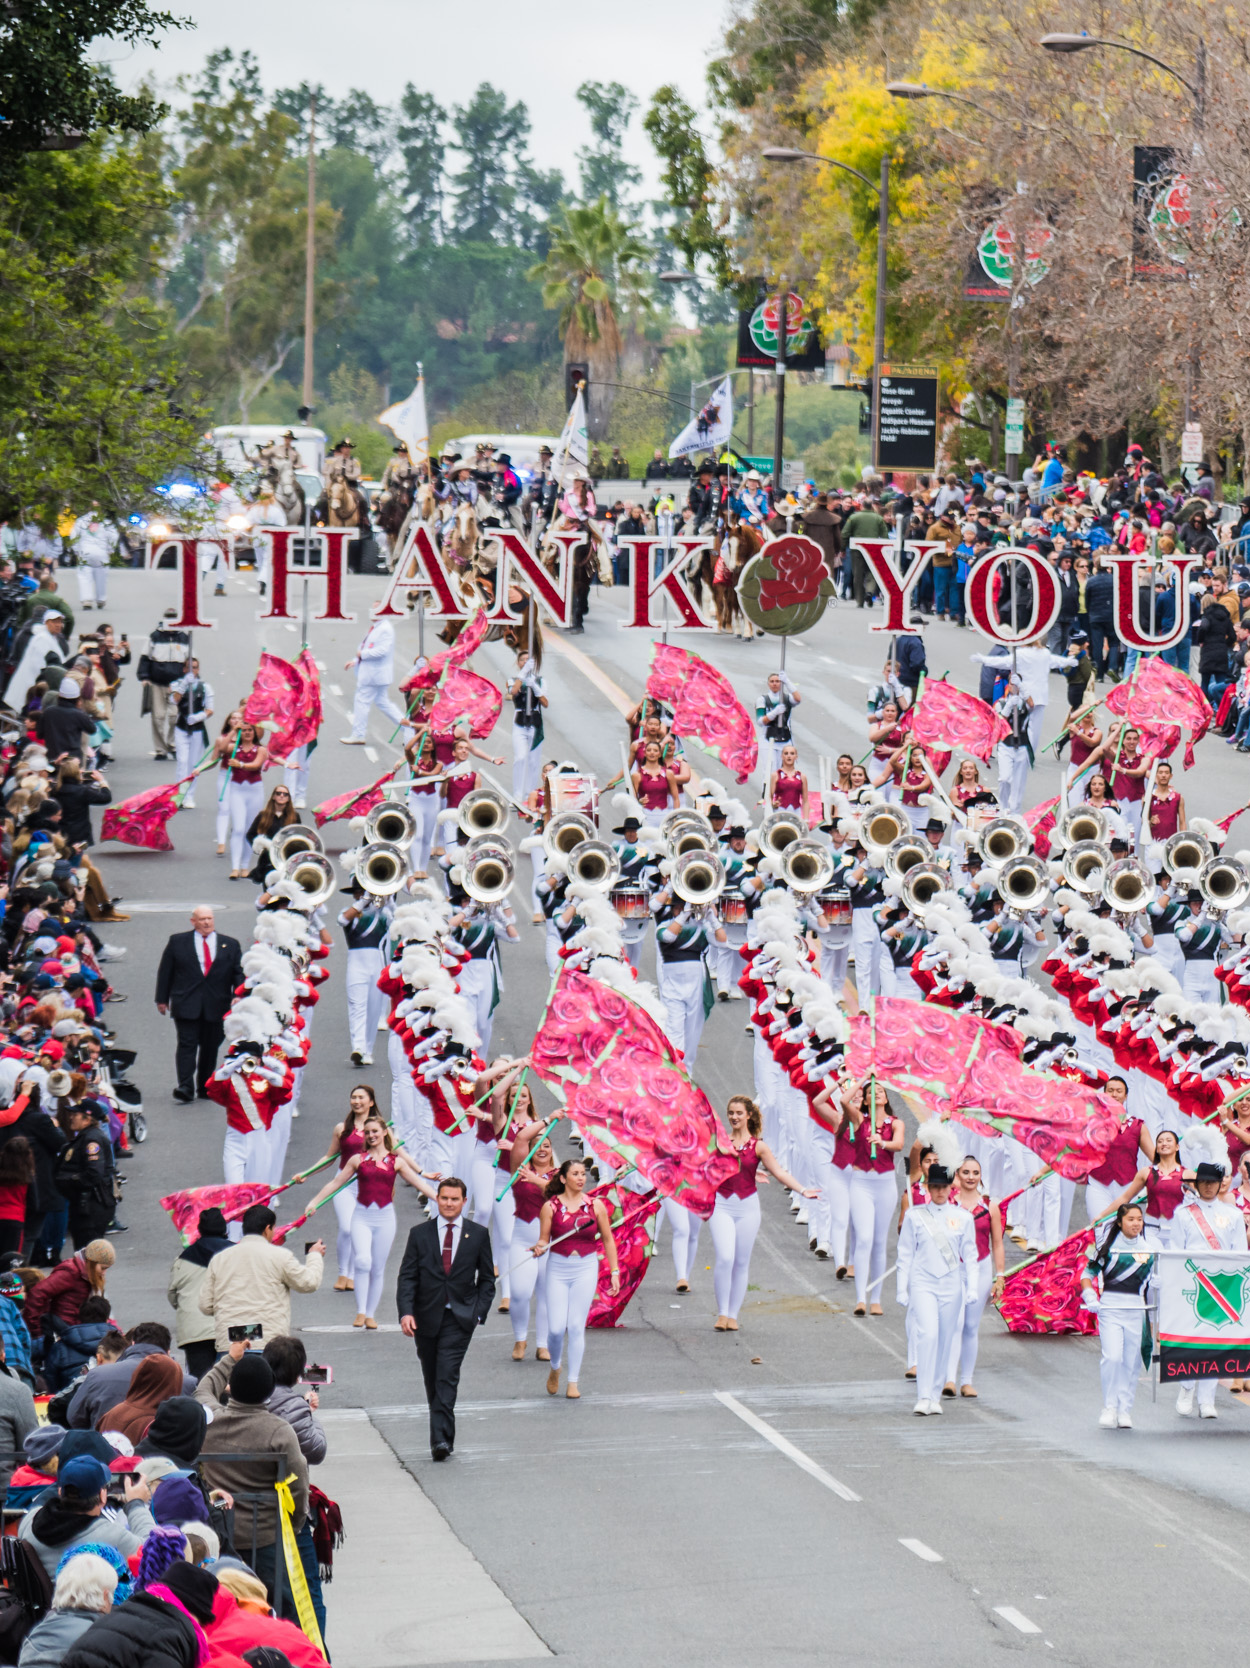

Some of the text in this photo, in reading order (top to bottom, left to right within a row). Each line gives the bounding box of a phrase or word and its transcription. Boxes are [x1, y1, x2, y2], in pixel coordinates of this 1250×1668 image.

[881, 388, 897, 396] Rose
[145, 520, 1203, 652] THANK YOU
[1167, 1361, 1220, 1376] SANTA
